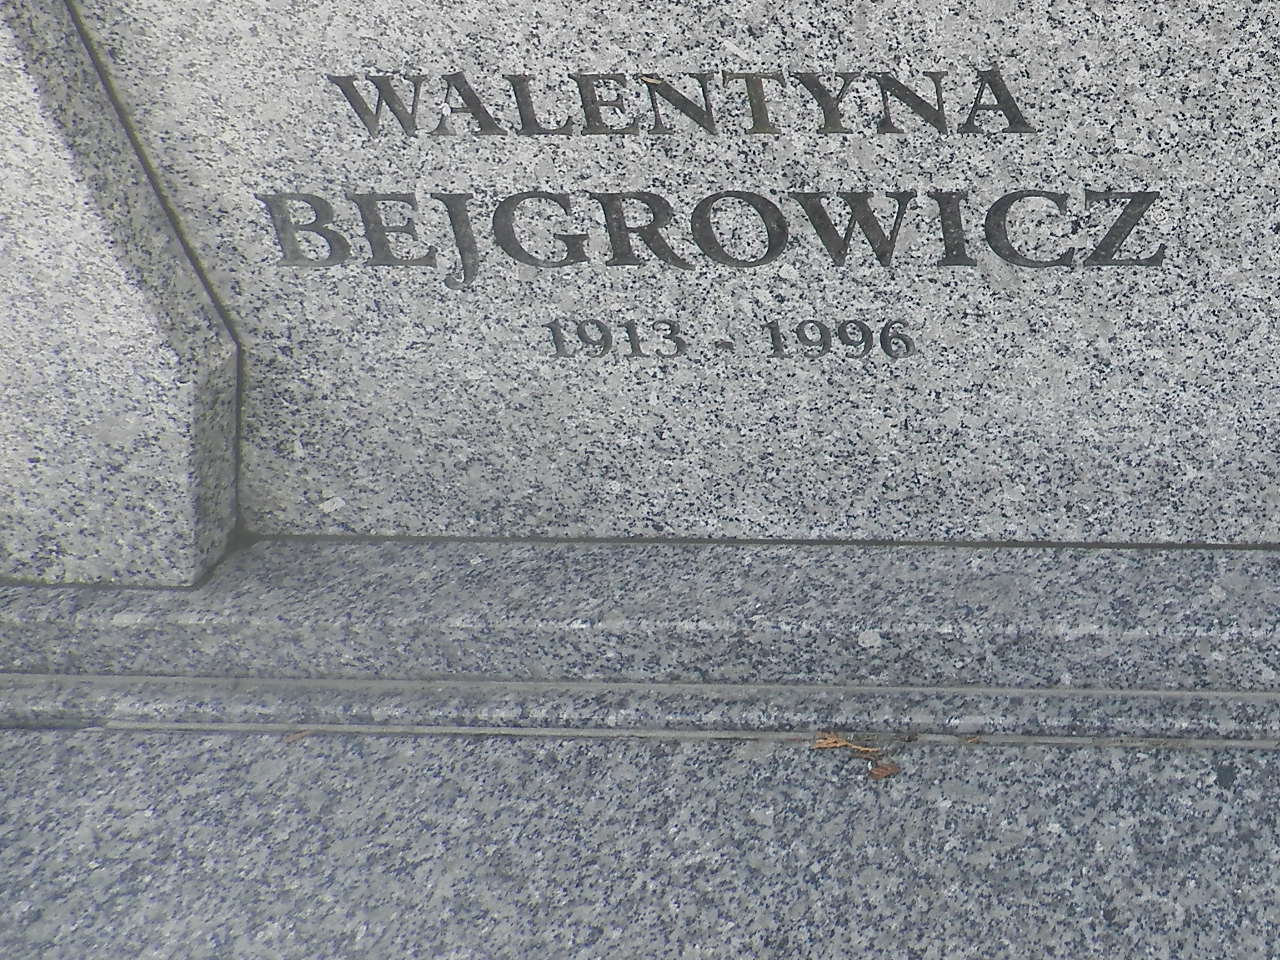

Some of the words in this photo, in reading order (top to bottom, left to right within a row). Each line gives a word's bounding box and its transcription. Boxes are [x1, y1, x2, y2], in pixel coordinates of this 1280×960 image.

[327, 68, 1037, 138] WALENTYNA
[256, 188, 1168, 290] BEJGROWICZ
[547, 317, 689, 360] 1913
[763, 316, 917, 360] 1996
